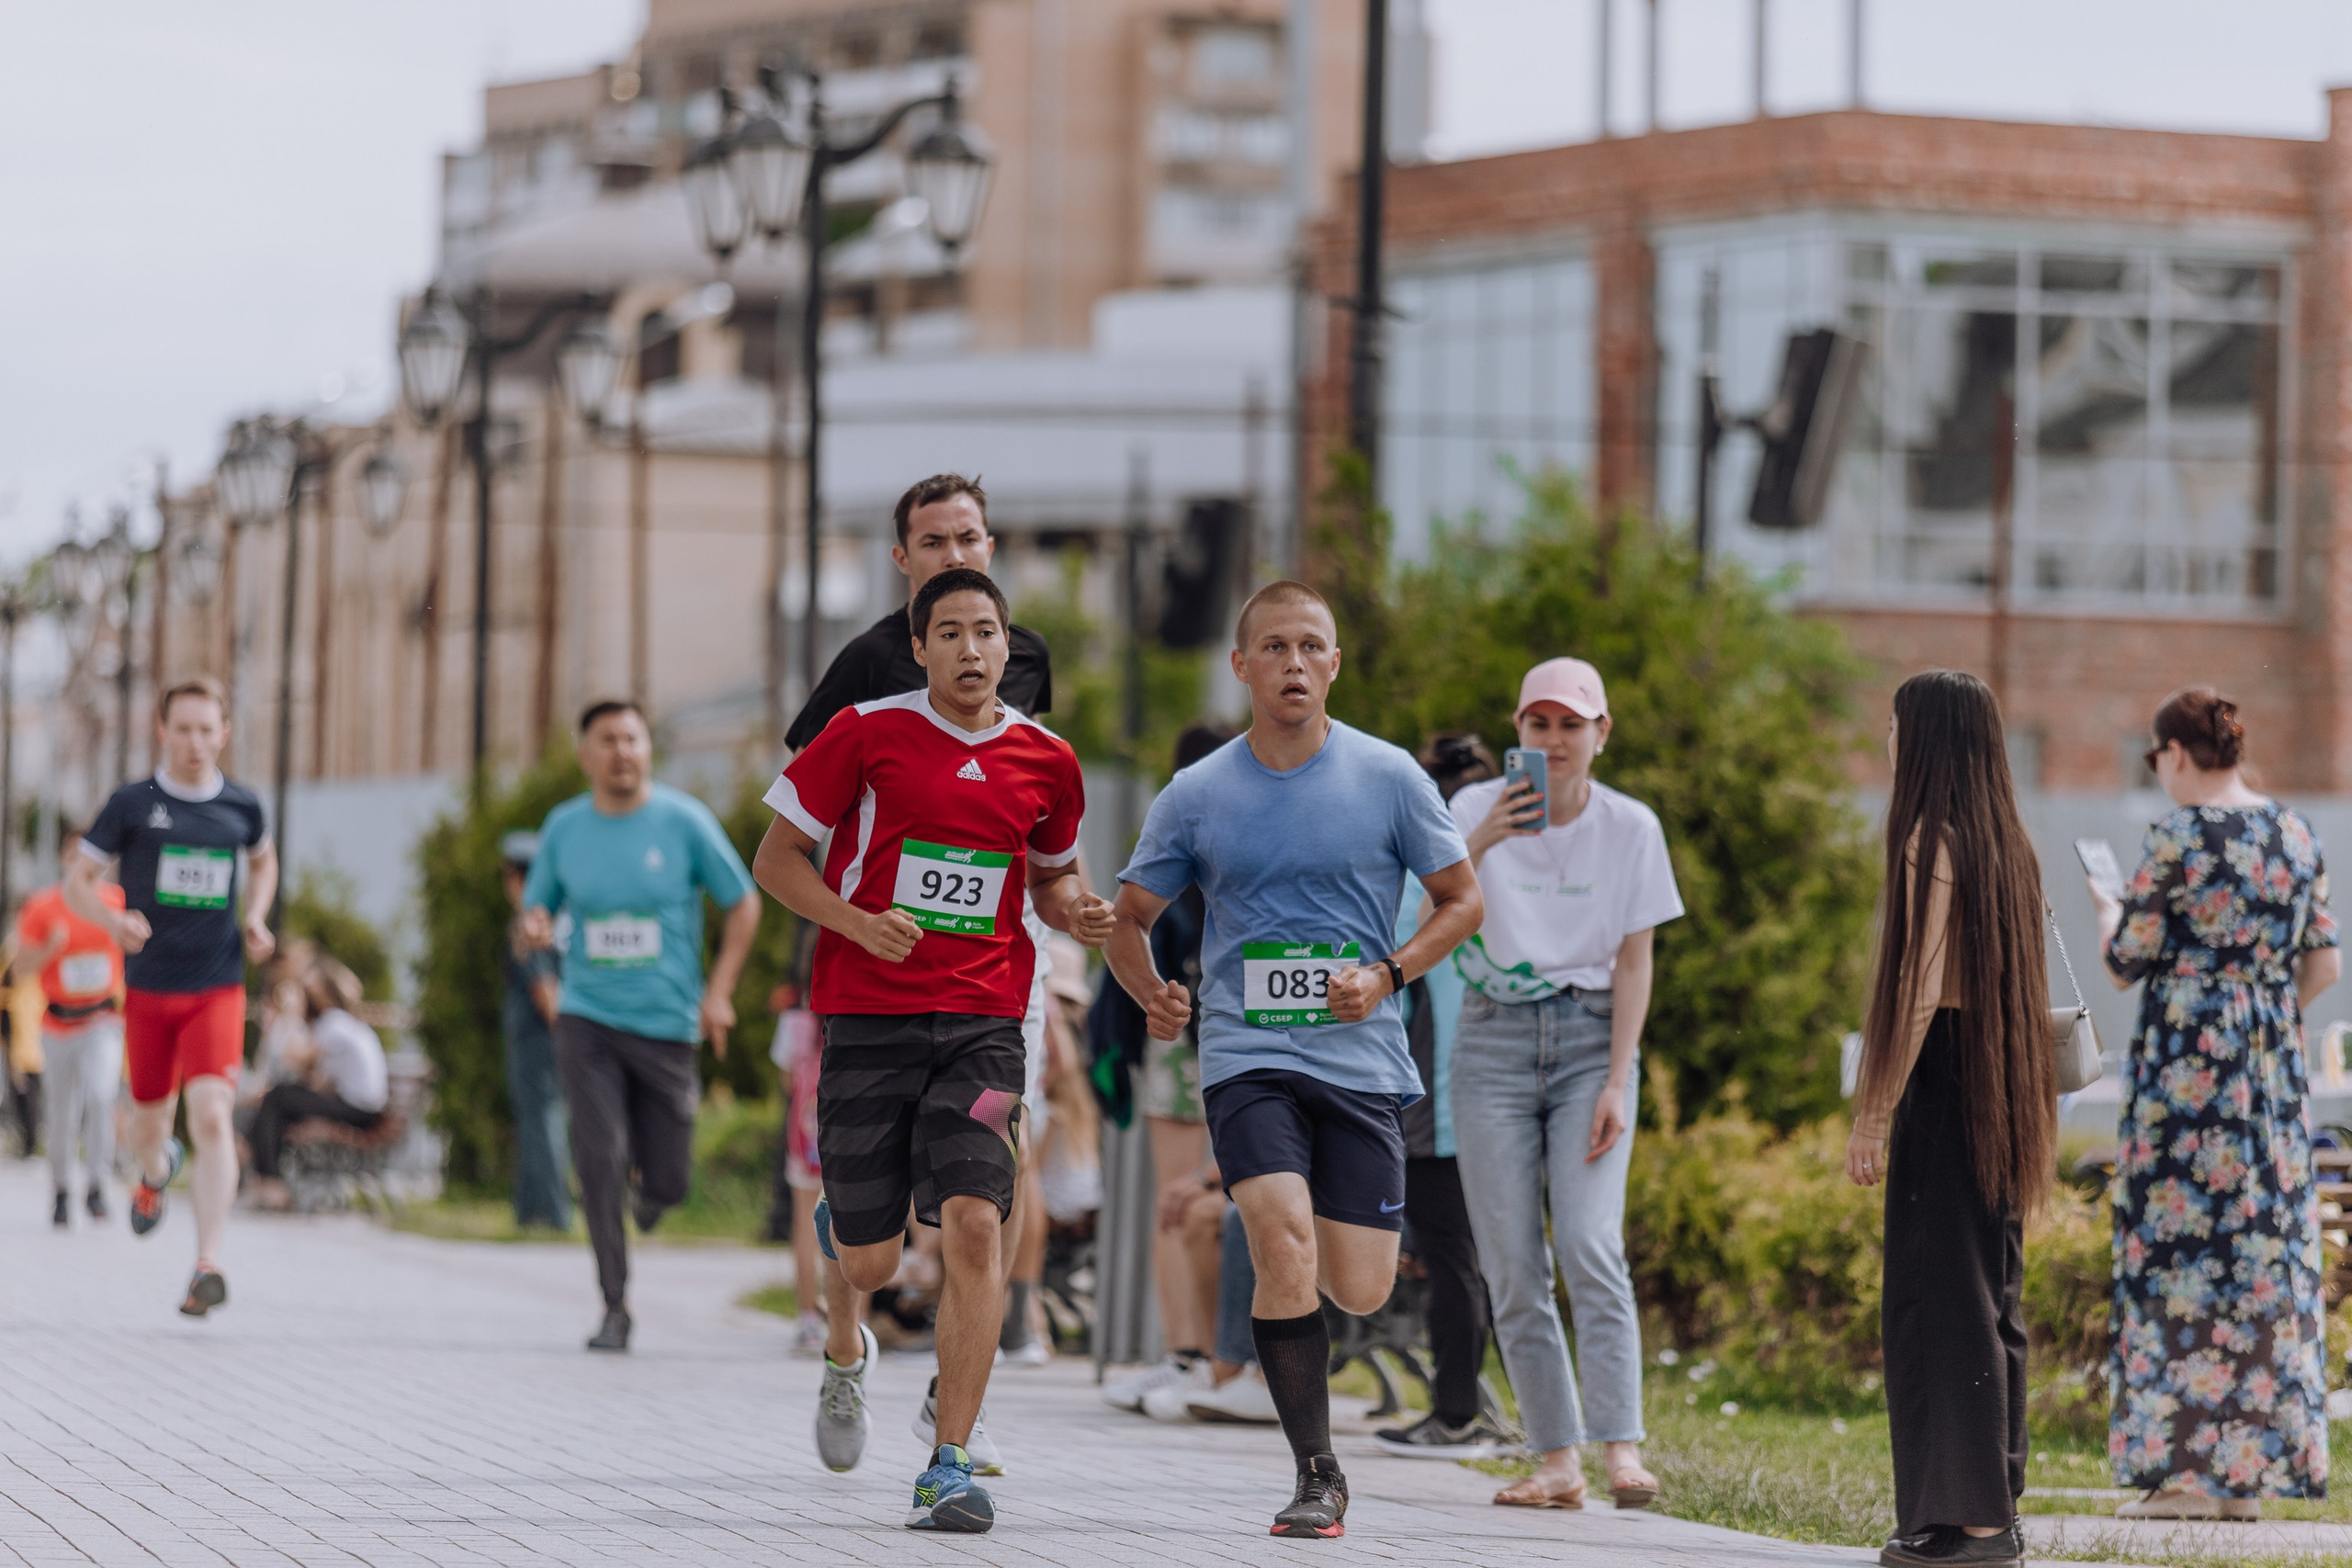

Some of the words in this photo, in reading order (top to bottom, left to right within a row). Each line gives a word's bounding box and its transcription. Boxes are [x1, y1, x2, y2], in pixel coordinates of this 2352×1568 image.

[956, 771, 987, 783] adidas
[920, 870, 984, 907] 923
[1267, 968, 1331, 999] 083
[1270, 1014, 1294, 1022] СБЕР
